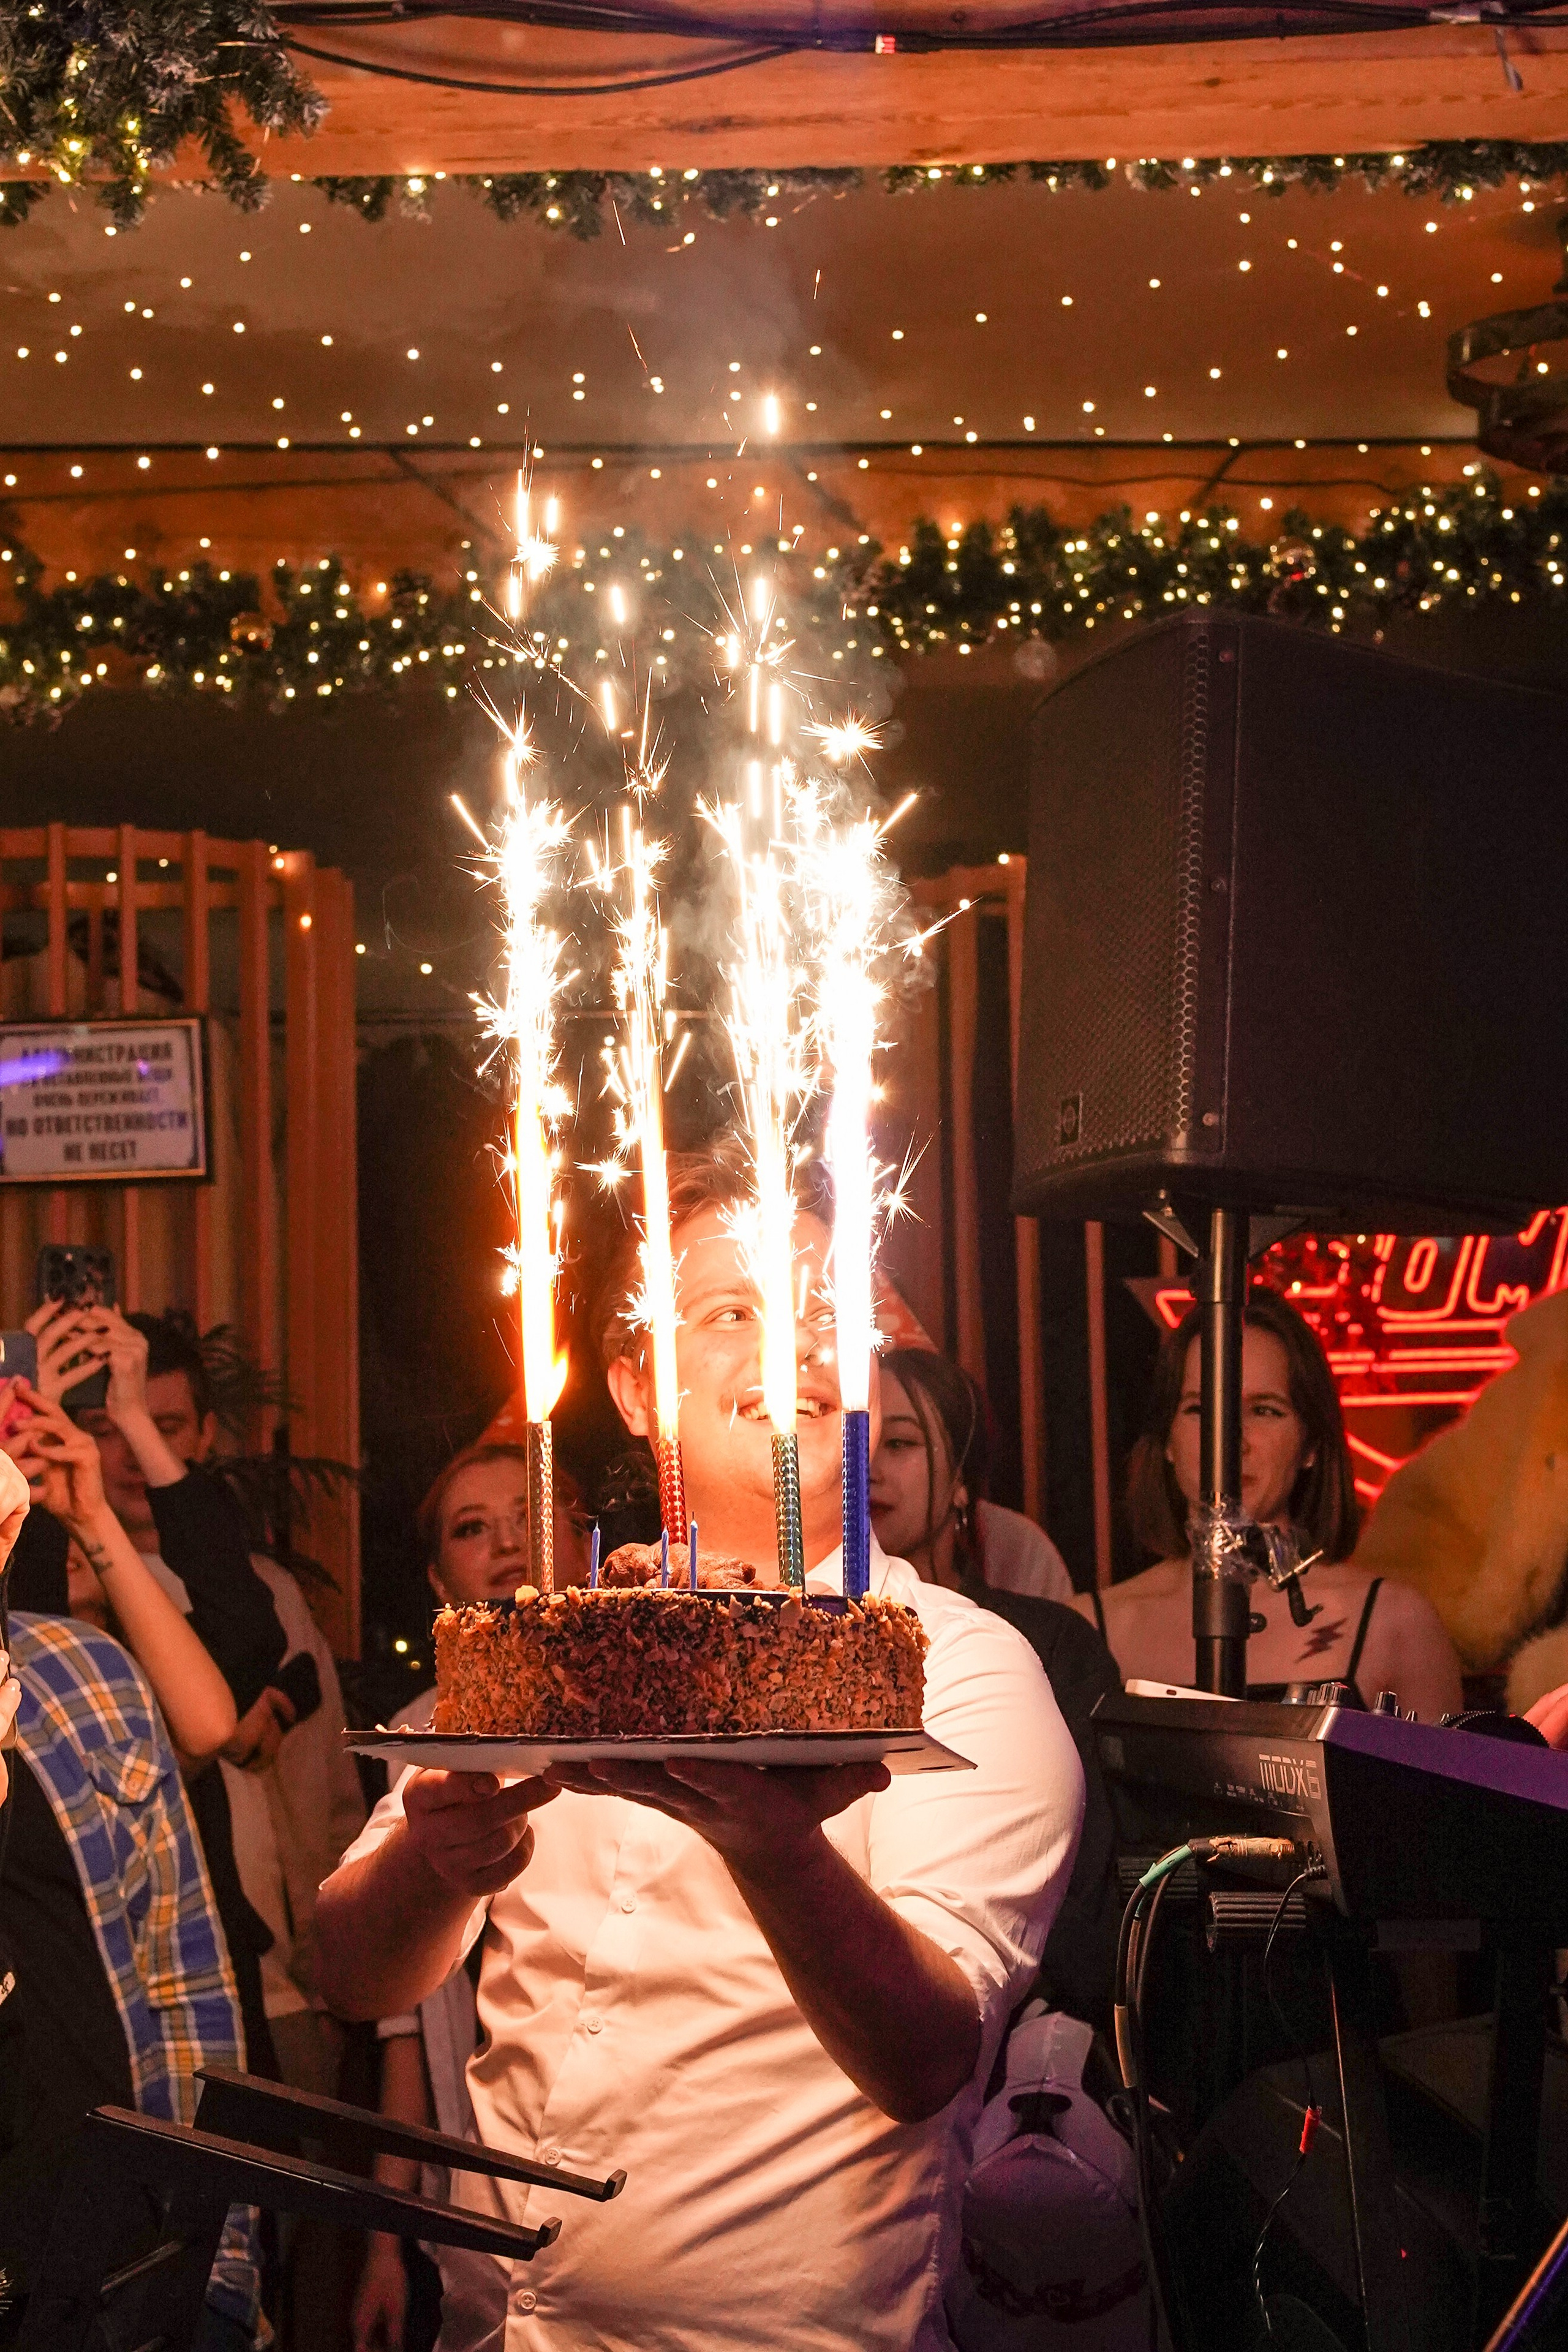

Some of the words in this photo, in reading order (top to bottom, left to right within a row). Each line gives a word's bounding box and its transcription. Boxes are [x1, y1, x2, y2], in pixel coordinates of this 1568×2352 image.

[6, 1117, 28, 1137] НО
[32, 1110, 189, 1136] ОТВЕТСТВЕННОСТИ
[63, 1142, 83, 1162] НЕ
[88, 1139, 137, 1161] НЕСЕТ
